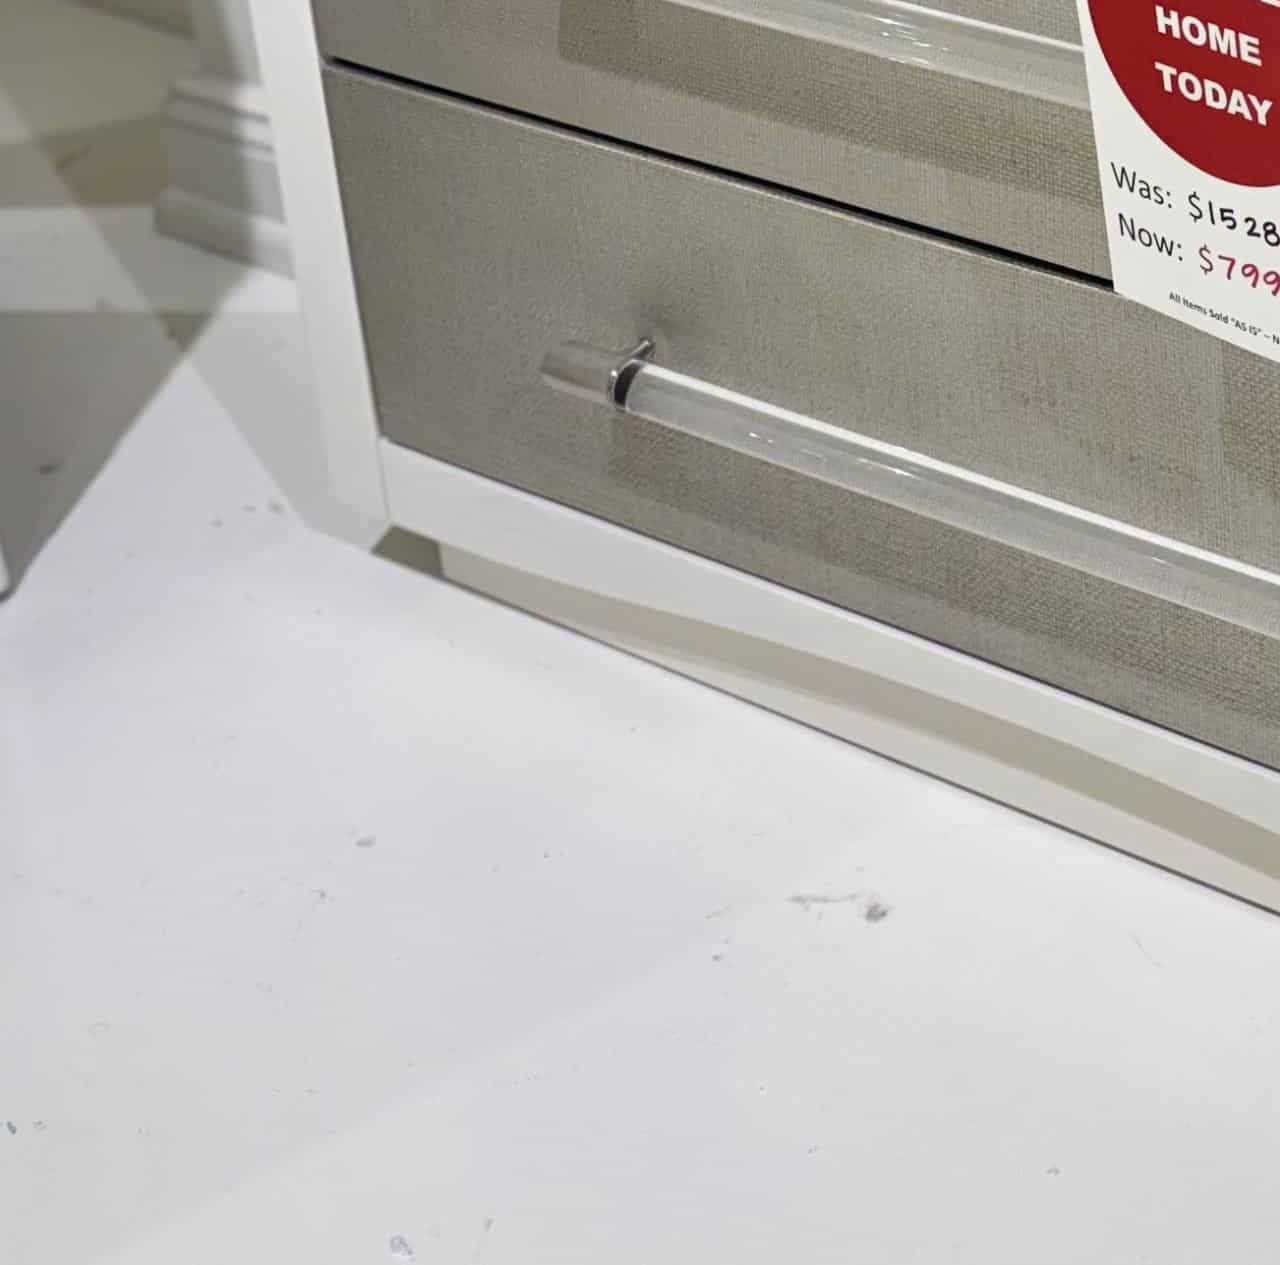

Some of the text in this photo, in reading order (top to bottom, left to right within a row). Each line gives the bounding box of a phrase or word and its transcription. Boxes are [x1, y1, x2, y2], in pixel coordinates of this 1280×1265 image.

[1155, 5, 1262, 66] HOME
[1154, 62, 1272, 127] TODAY
[1111, 162, 1280, 247] Was: $1528
[1118, 213, 1183, 261] Now:
[1169, 292, 1181, 304] All
[1183, 298, 1207, 315] Items
[1209, 309, 1229, 324] Sold
